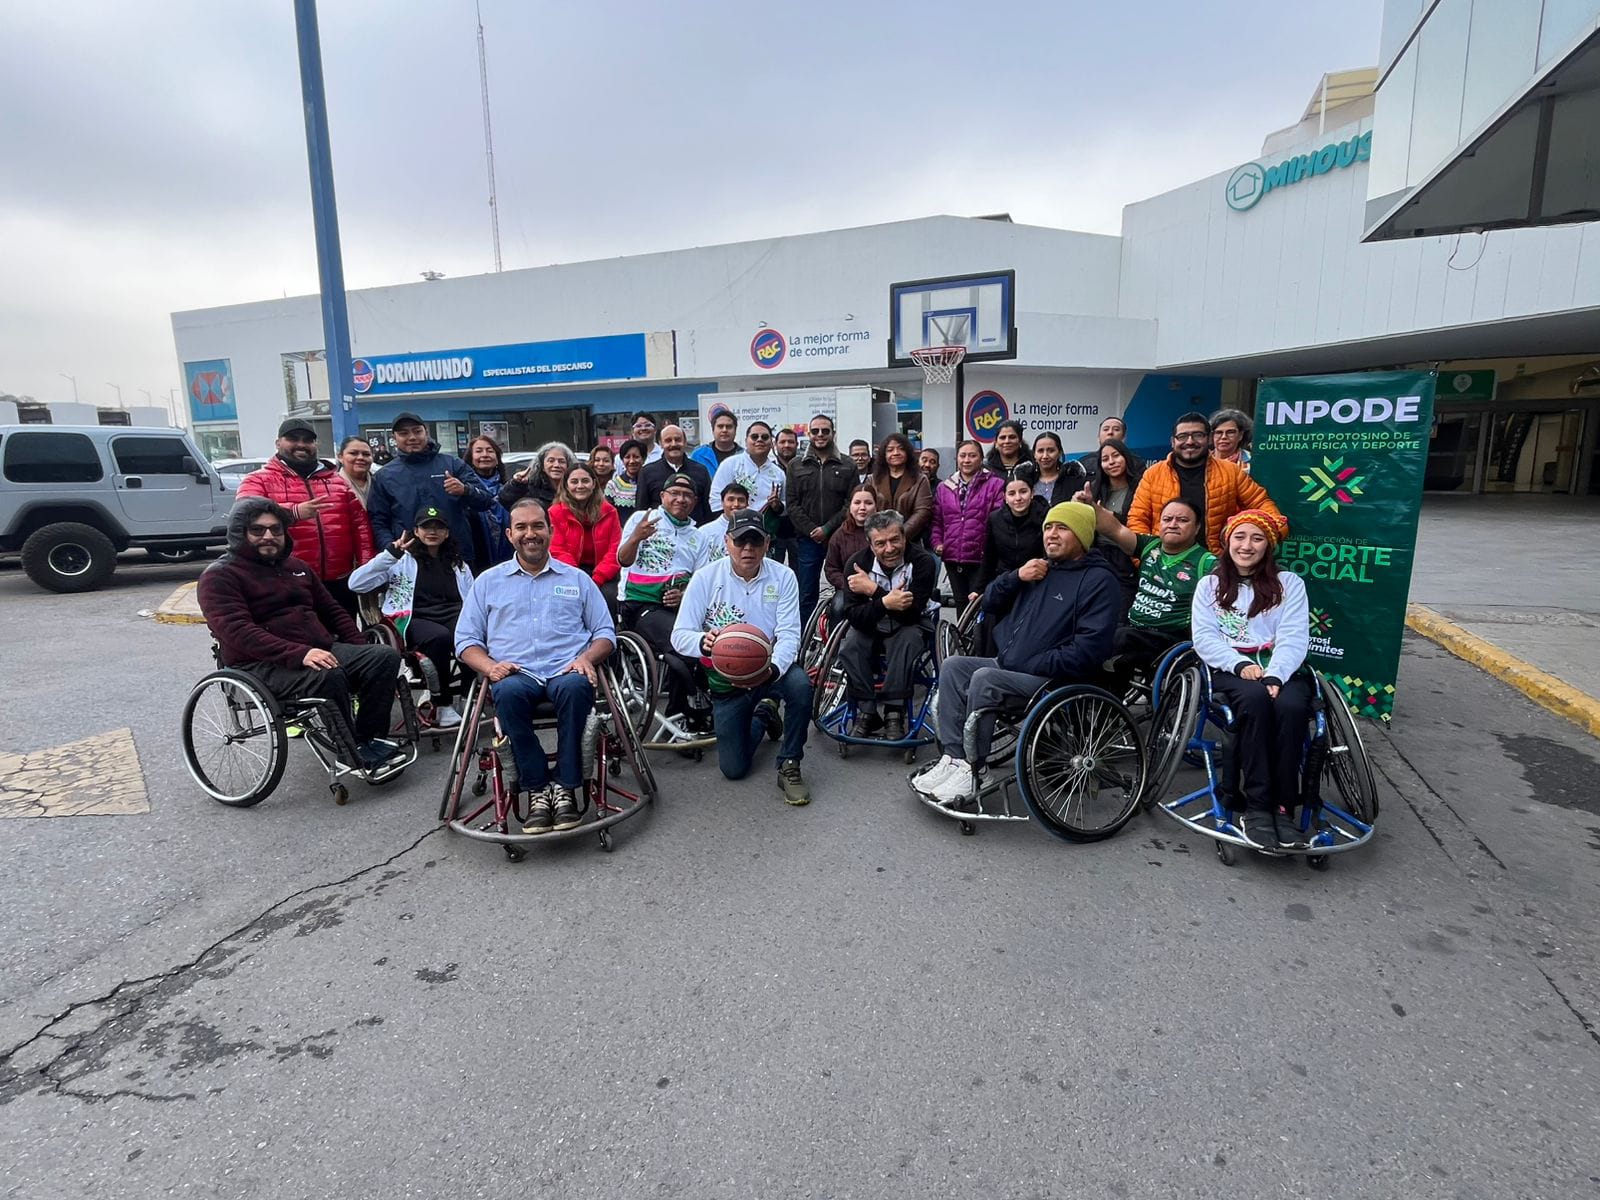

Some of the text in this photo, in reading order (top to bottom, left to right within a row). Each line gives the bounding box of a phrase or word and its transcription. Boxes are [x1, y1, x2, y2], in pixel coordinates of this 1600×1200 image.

[789, 330, 870, 346] La mejor forma
[757, 341, 780, 361] RAC
[789, 345, 850, 358] de comprar
[376, 357, 472, 384] DORMIMUNDO
[483, 361, 594, 377] ESPECIALISTAS DEL DESCANSO
[1013, 402, 1099, 417] La mejor forma
[1265, 396, 1421, 426] INPODE
[974, 407, 1003, 430] RAC
[1030, 419, 1078, 431] comprar
[1268, 432, 1411, 442] INSTITUTO POTOSINO DE
[1259, 440, 1420, 451] CULTURA FÍSICA Y DEPORTE
[1355, 538, 1369, 546] DE
[1138, 577, 1177, 602] Canel's
